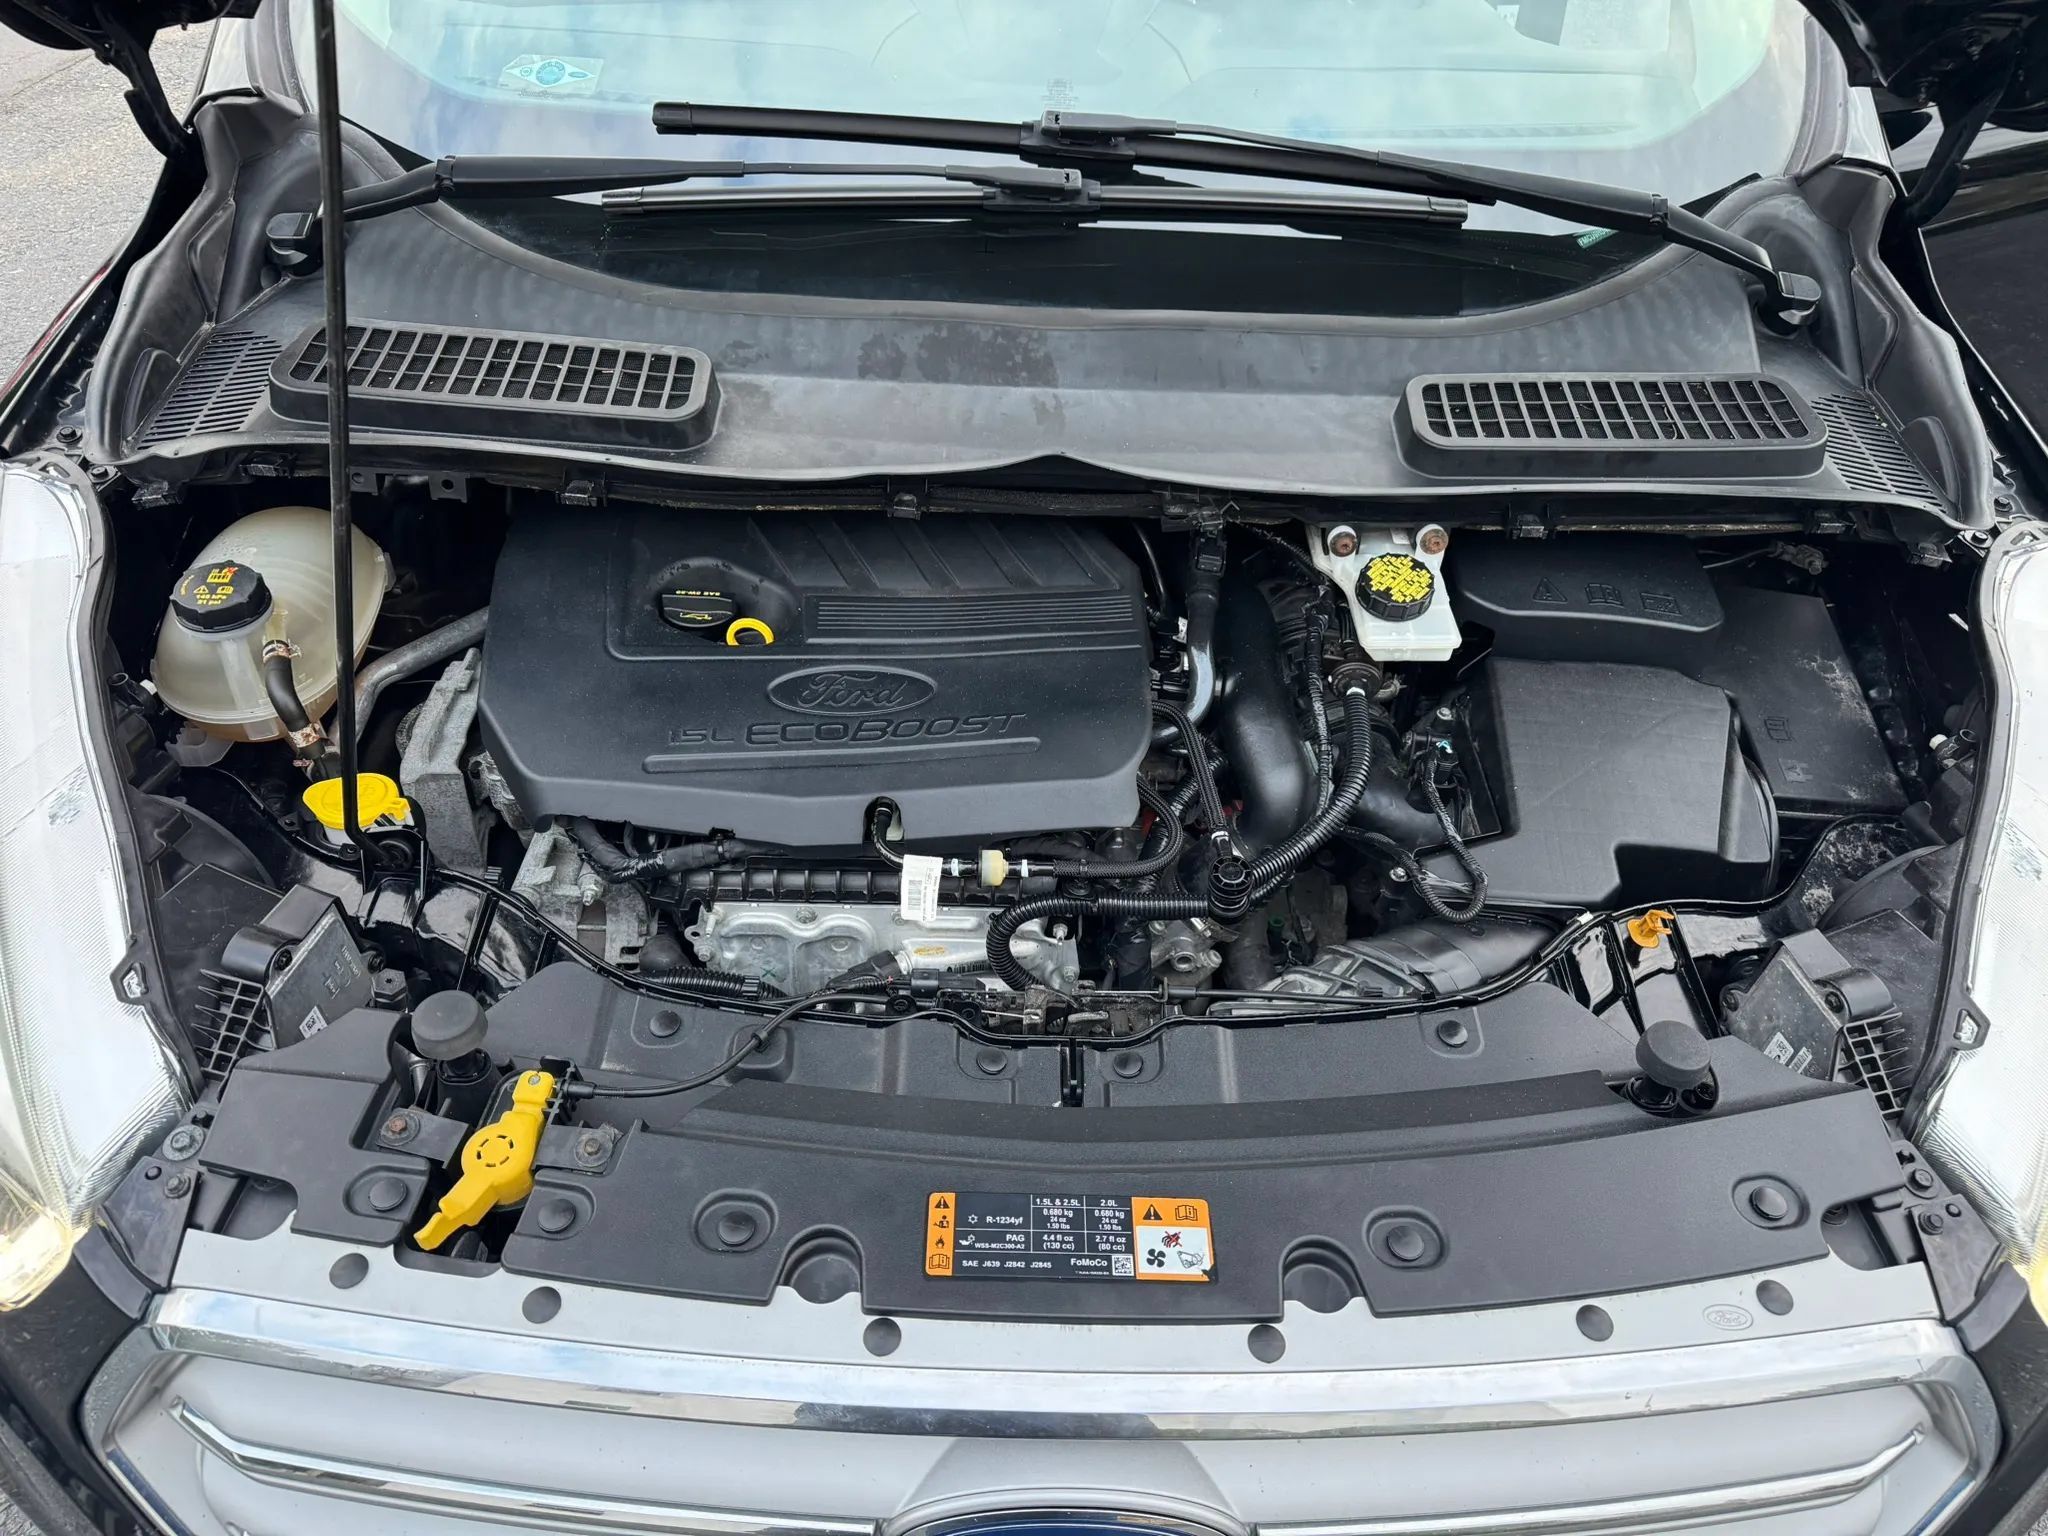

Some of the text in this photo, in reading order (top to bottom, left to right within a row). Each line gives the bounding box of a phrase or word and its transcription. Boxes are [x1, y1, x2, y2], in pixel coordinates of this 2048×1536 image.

[797, 670, 911, 709] Ford
[1035, 1198, 1081, 1207] 1.5L & 2.5L
[1100, 1199, 1118, 1207] 2.0L
[1063, 1208, 1073, 1217] kg
[1115, 1210, 1125, 1219] kg
[985, 1215, 1024, 1226] R-1234yf
[1005, 1234, 1025, 1242] PAG
[1095, 1235, 1107, 1243] 2.7
[1043, 1242, 1075, 1251] (130 cc)
[1098, 1243, 1126, 1252] (80 cc)
[982, 1260, 1001, 1268] J639
[1070, 1258, 1108, 1267] FoMoCo
